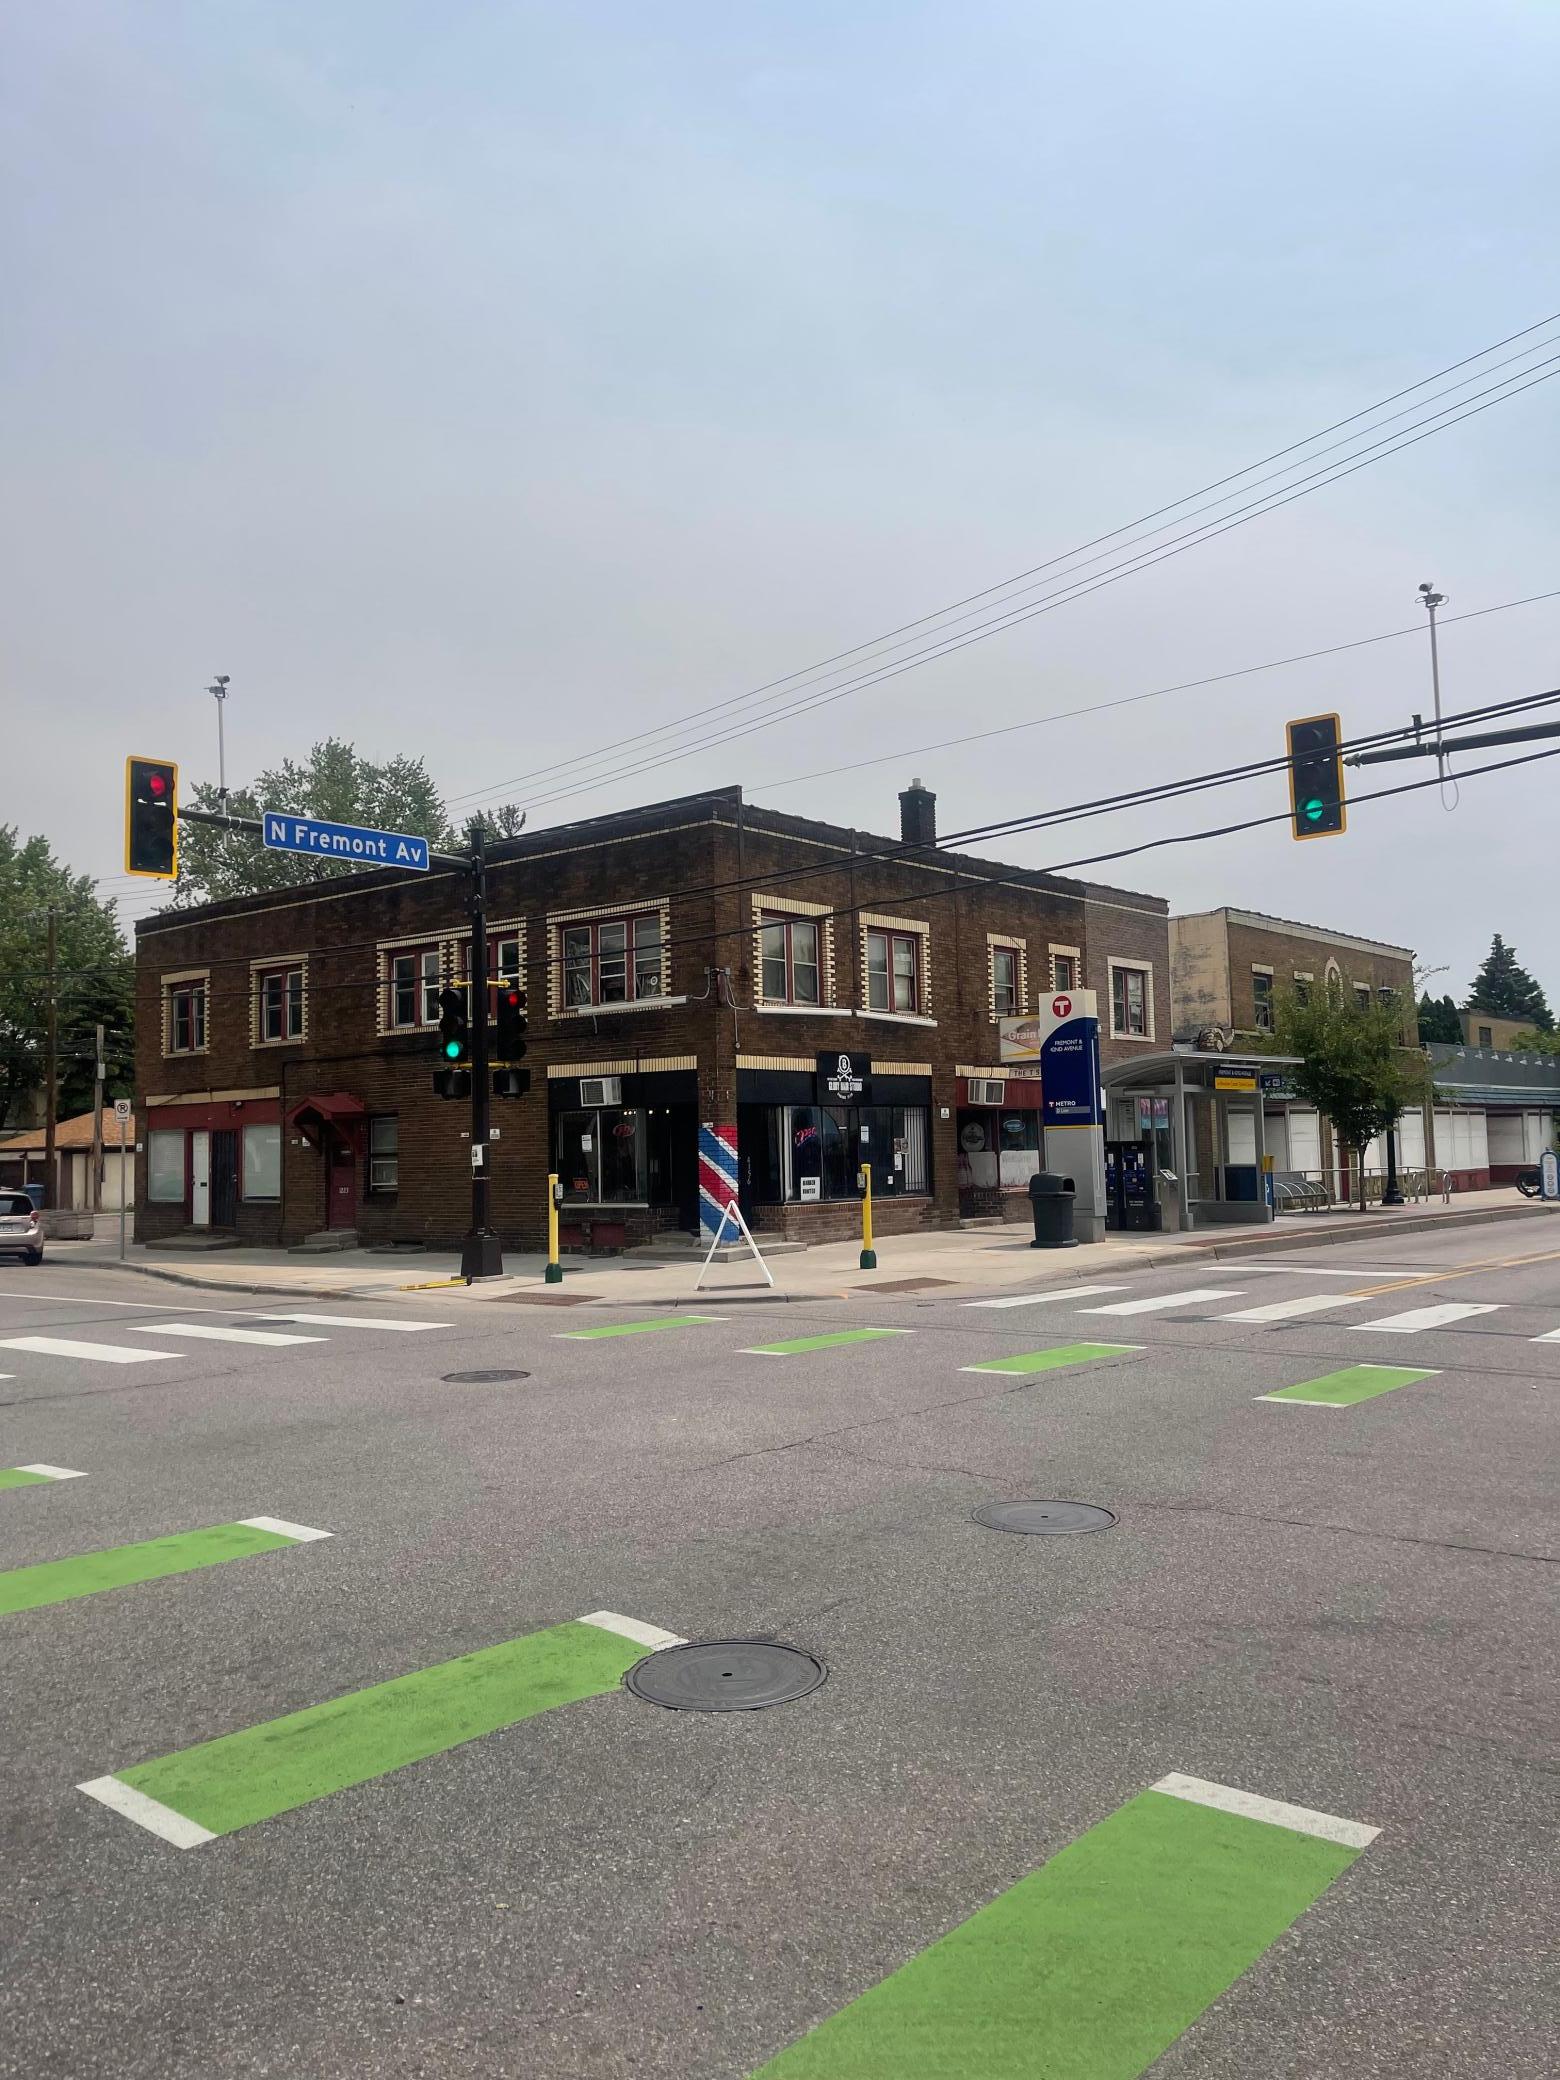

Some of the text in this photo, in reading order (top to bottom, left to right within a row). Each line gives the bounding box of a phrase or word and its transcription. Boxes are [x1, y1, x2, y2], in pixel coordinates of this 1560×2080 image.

[271, 821, 422, 862] N Fremont Av
[1054, 1000, 1070, 1015] T
[1008, 1029, 1036, 1041] Grain
[1014, 1069, 1026, 1077] THE
